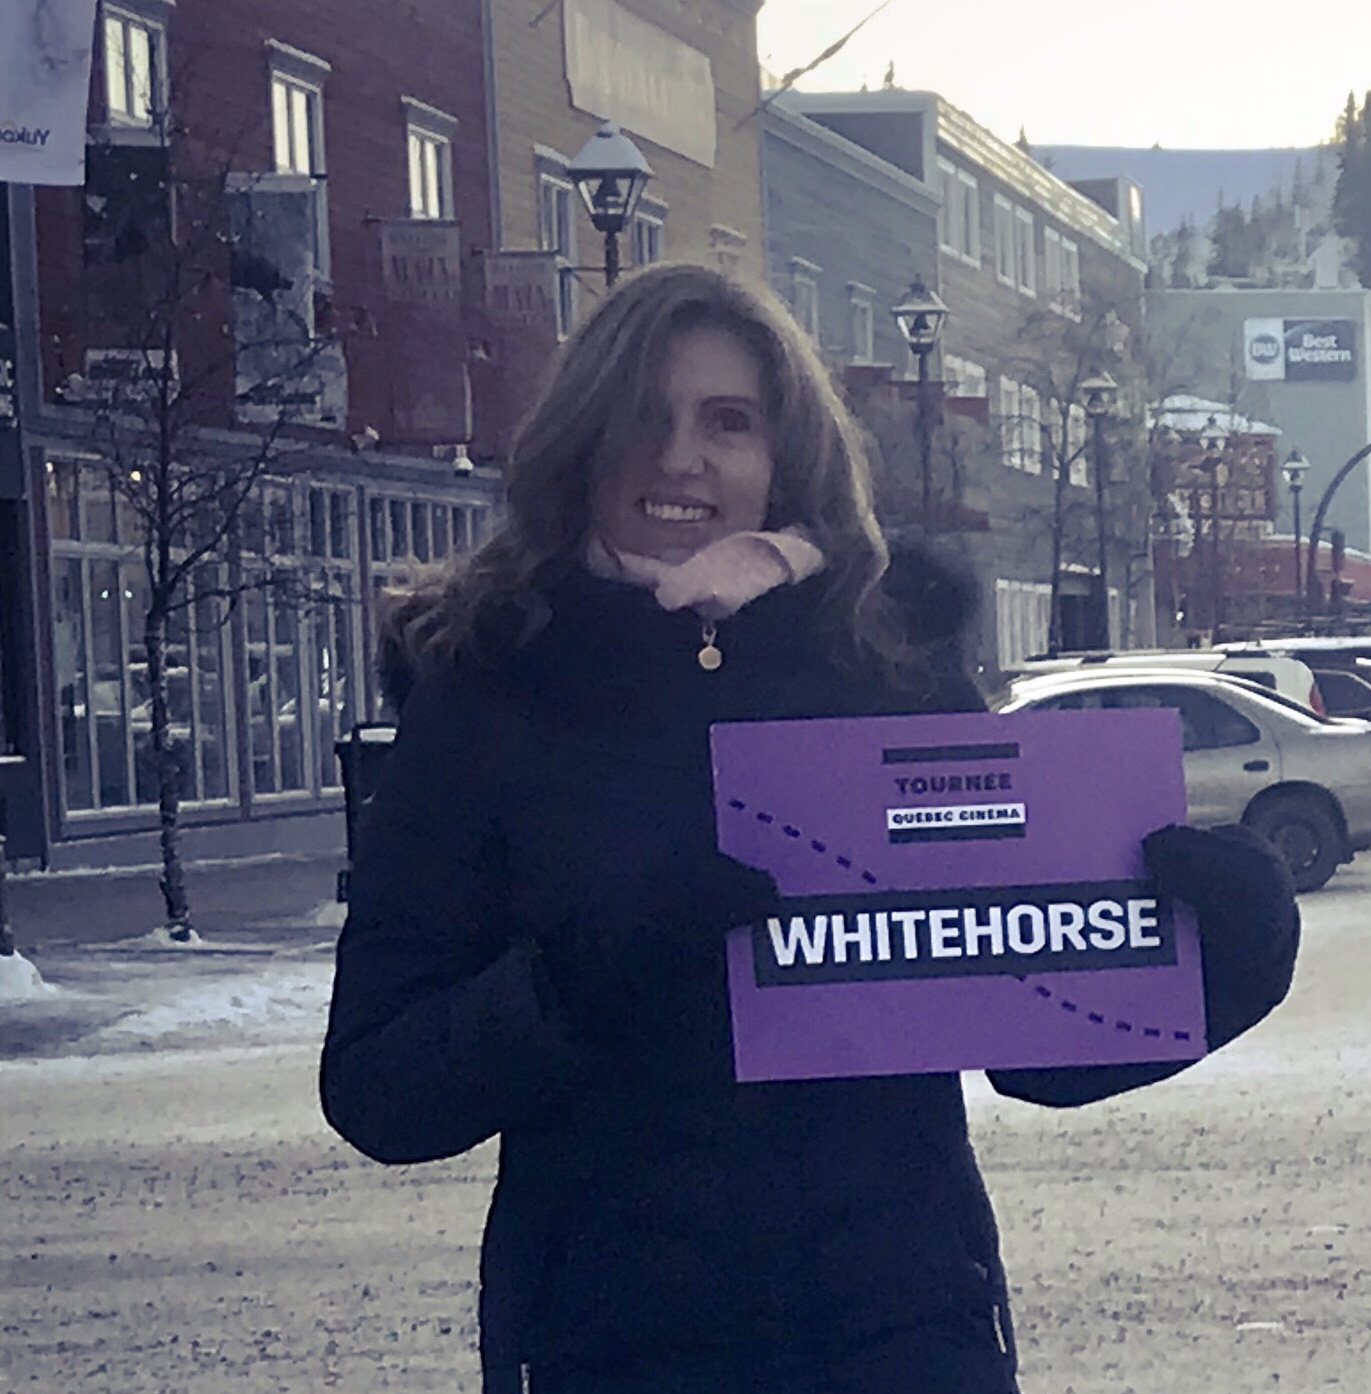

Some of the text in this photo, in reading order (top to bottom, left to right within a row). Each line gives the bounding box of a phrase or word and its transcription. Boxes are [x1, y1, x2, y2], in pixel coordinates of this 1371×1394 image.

[1303, 333, 1338, 348] Best
[1288, 347, 1352, 362] Western
[894, 772, 1012, 795] TOURNÉE
[767, 898, 1162, 966] WHITEHORSE
